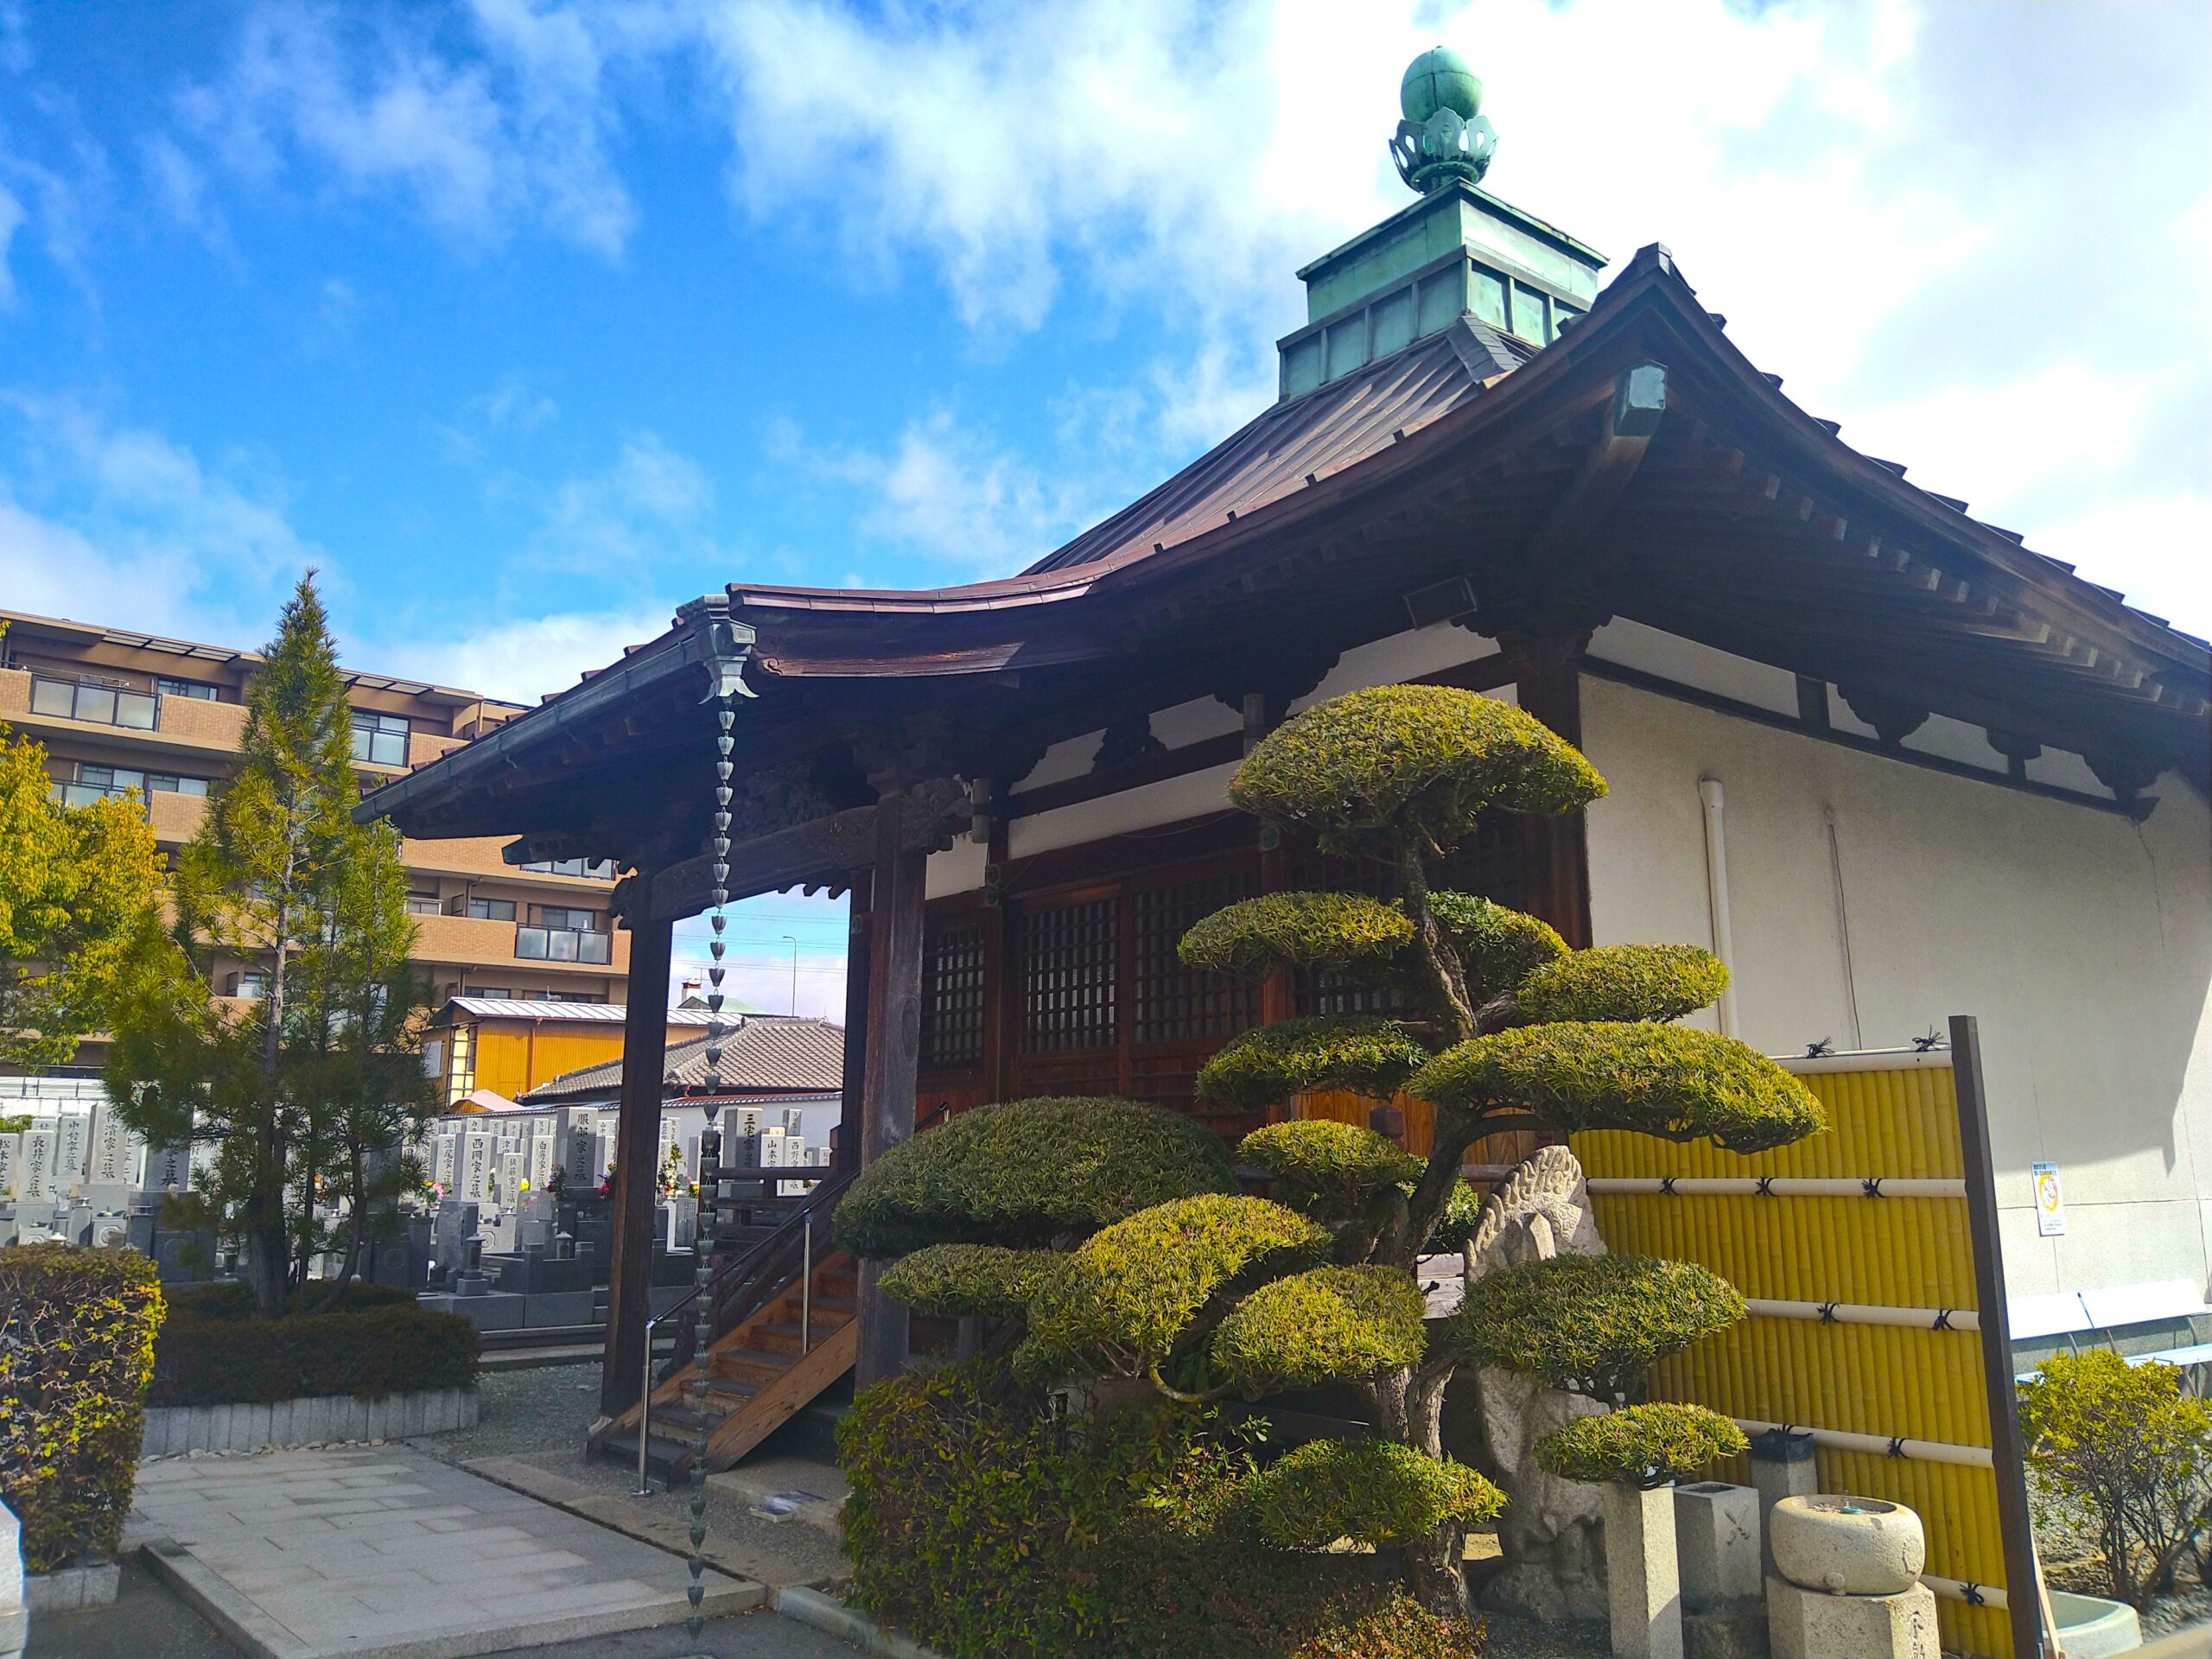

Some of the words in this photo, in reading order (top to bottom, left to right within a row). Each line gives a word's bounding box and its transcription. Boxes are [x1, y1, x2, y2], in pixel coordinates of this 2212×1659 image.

[26, 1135, 45, 1198] 長井家之墓
[65, 1121, 79, 1171] 中村家之墓
[469, 1138, 484, 1198] 西岡家之墓
[573, 1113, 589, 1181] 服部家之墓
